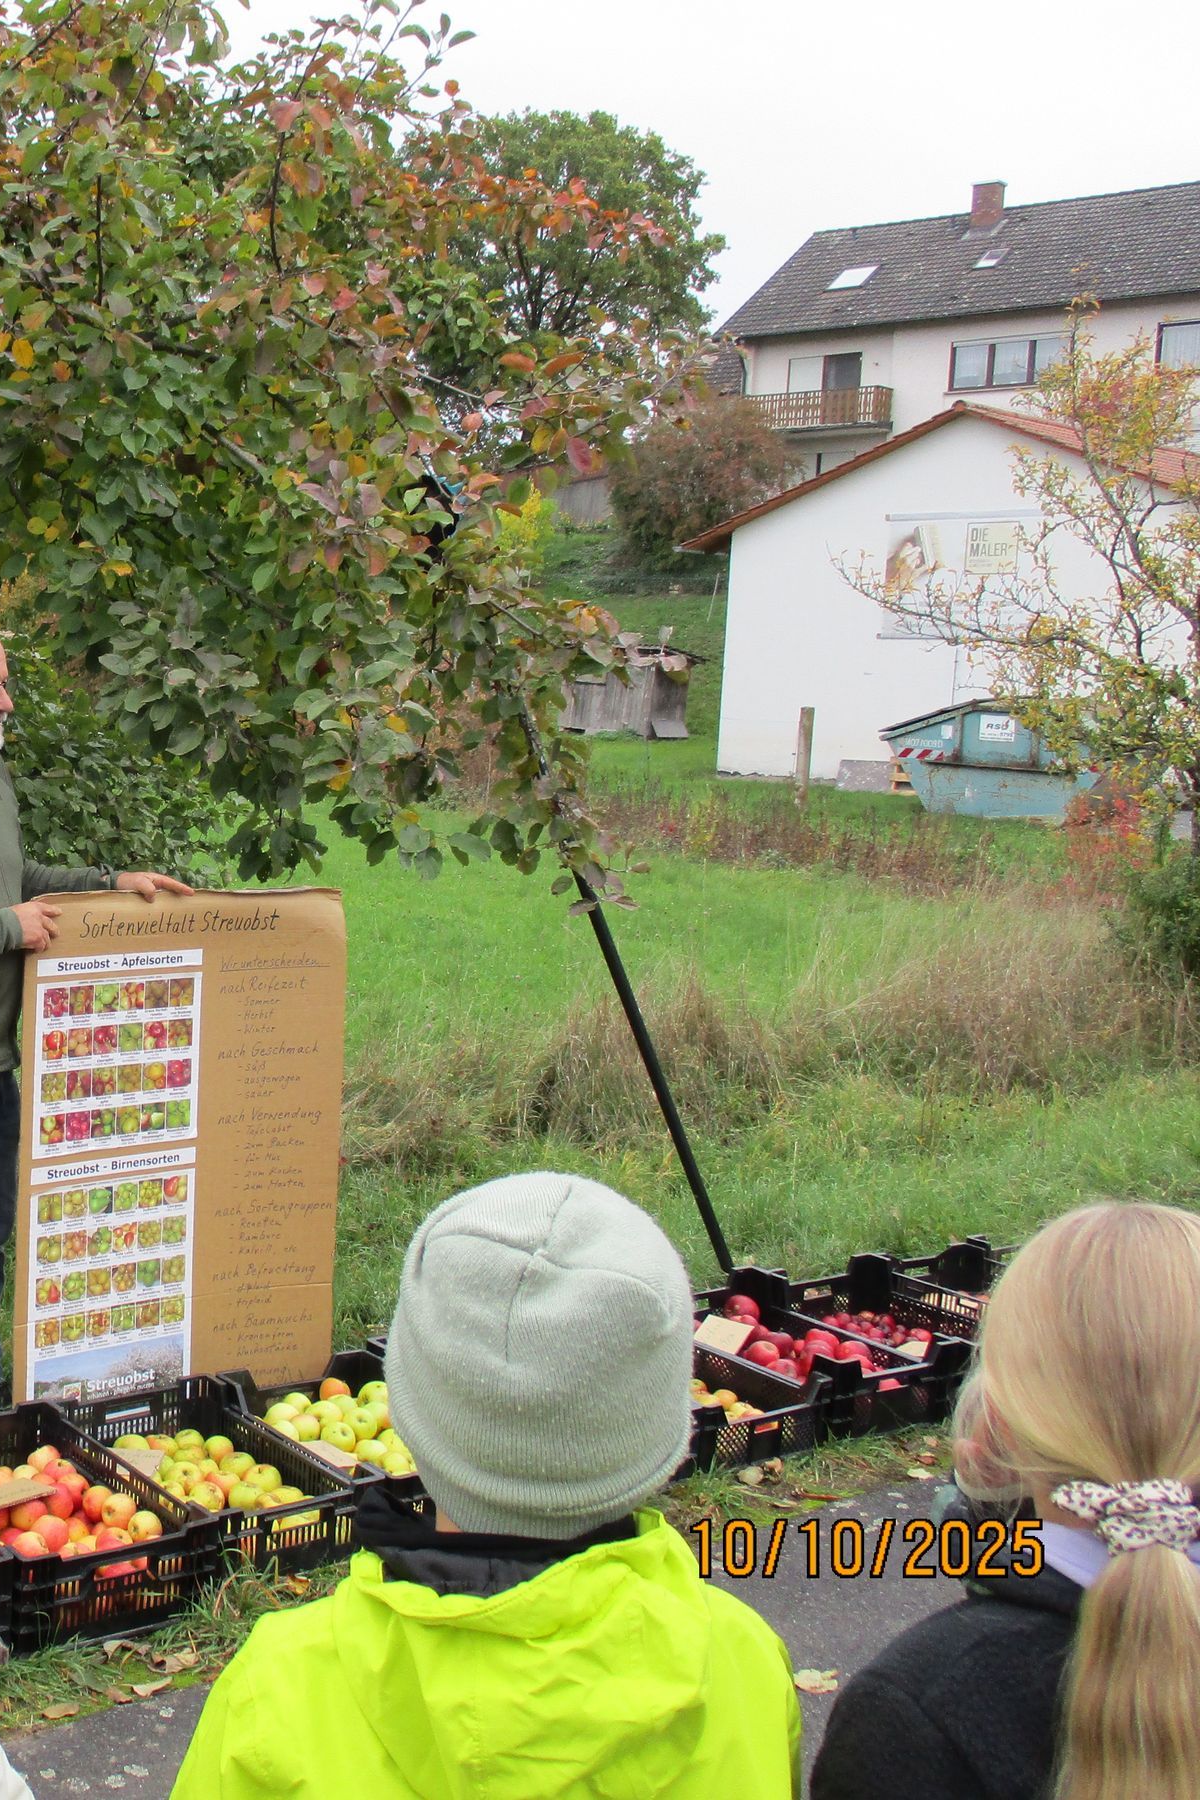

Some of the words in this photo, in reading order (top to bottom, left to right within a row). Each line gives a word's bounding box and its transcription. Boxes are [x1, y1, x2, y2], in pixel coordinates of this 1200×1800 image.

[971, 527, 989, 542] DIE
[969, 543, 1008, 557] MALER
[80, 911, 195, 939] Sortenvielfalt
[200, 907, 280, 932] Streuobst
[57, 959, 110, 972] Streuobst
[121, 954, 183, 968] Apfelsorten
[220, 979, 245, 994] nach
[249, 976, 308, 993] Reifezeit
[244, 1010, 273, 1021] Herbst
[243, 1024, 276, 1035] Winter
[218, 1044, 246, 1060] nach
[251, 1041, 320, 1058] Geschmack
[217, 1108, 245, 1125] nach
[251, 1106, 322, 1125] Verwendung
[47, 1163, 100, 1179] Streuobst
[111, 1153, 180, 1171] Birnensorten
[215, 1200, 241, 1217] nach
[213, 1264, 240, 1281] nach
[86, 1369, 156, 1392] Streuobst
